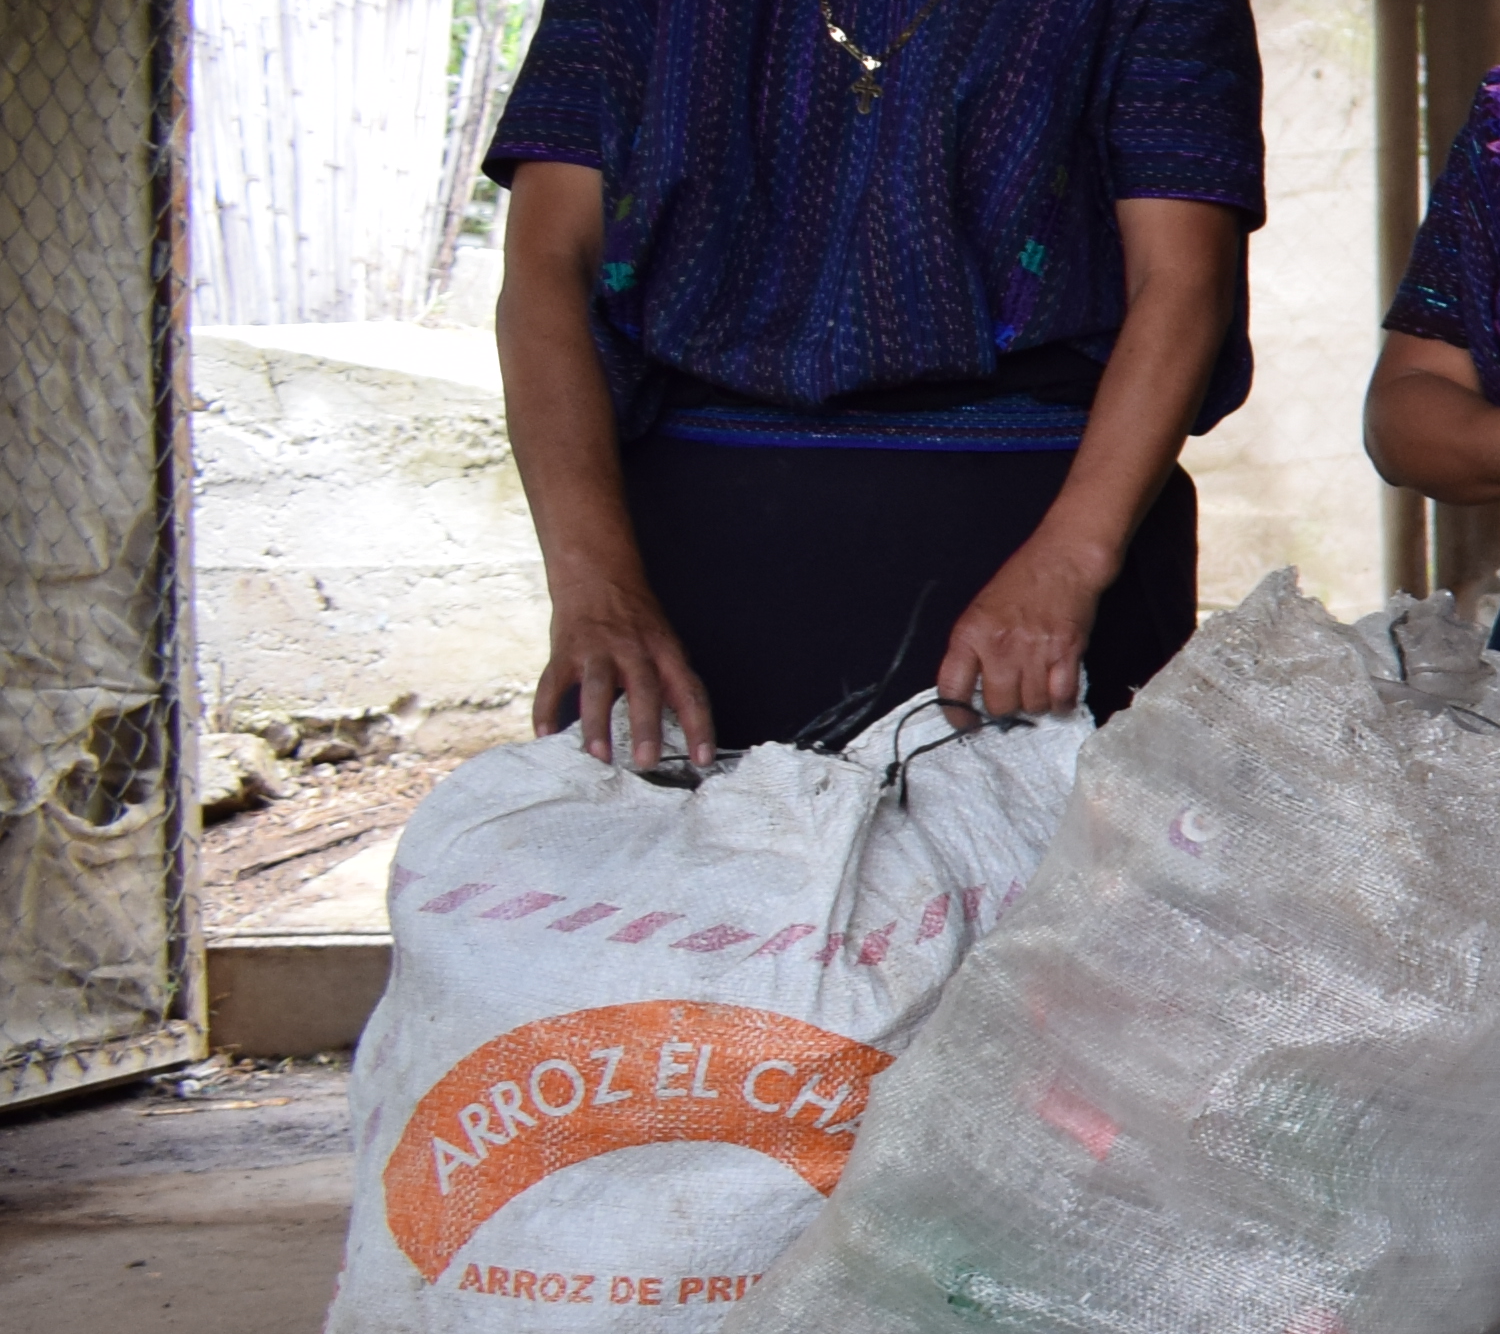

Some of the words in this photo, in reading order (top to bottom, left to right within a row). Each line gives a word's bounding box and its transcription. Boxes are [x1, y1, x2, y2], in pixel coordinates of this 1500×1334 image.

[431, 1044, 633, 1196] ARROZ
[655, 1037, 719, 1100] EL
[458, 1262, 595, 1304] ARROZ
[610, 1274, 662, 1306] DE
